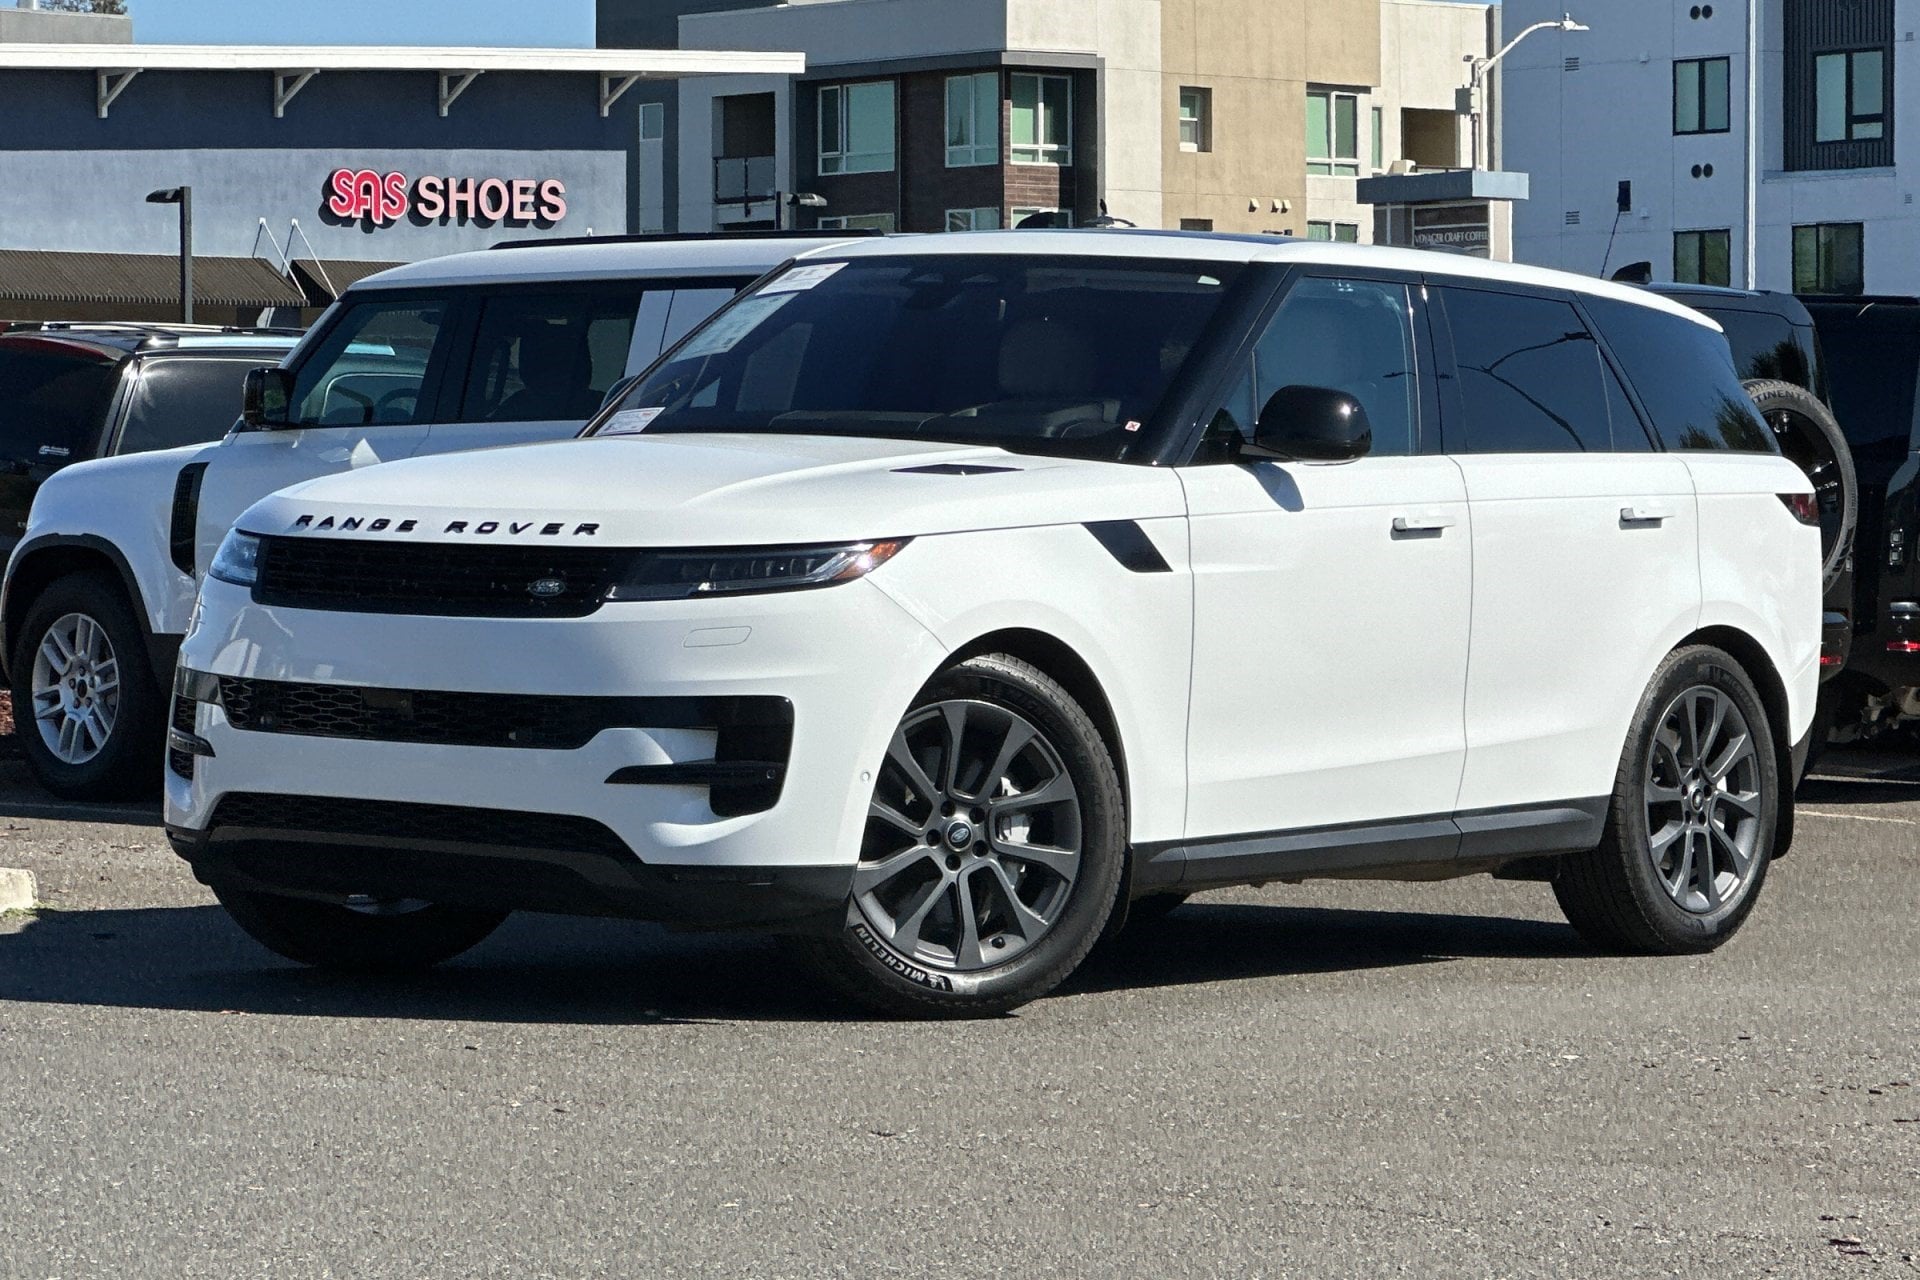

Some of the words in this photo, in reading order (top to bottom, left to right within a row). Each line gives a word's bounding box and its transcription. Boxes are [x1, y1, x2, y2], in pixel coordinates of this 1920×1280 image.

[329, 168, 408, 225] SAS
[416, 175, 568, 222] SHOES
[1414, 233, 1444, 244] VOYAGER
[1444, 231, 1465, 243] CRAFT
[1465, 230, 1489, 241] COFFEE
[293, 514, 418, 534] RANGE
[444, 520, 601, 537] ROVER
[855, 926, 926, 983] MICHELIN
